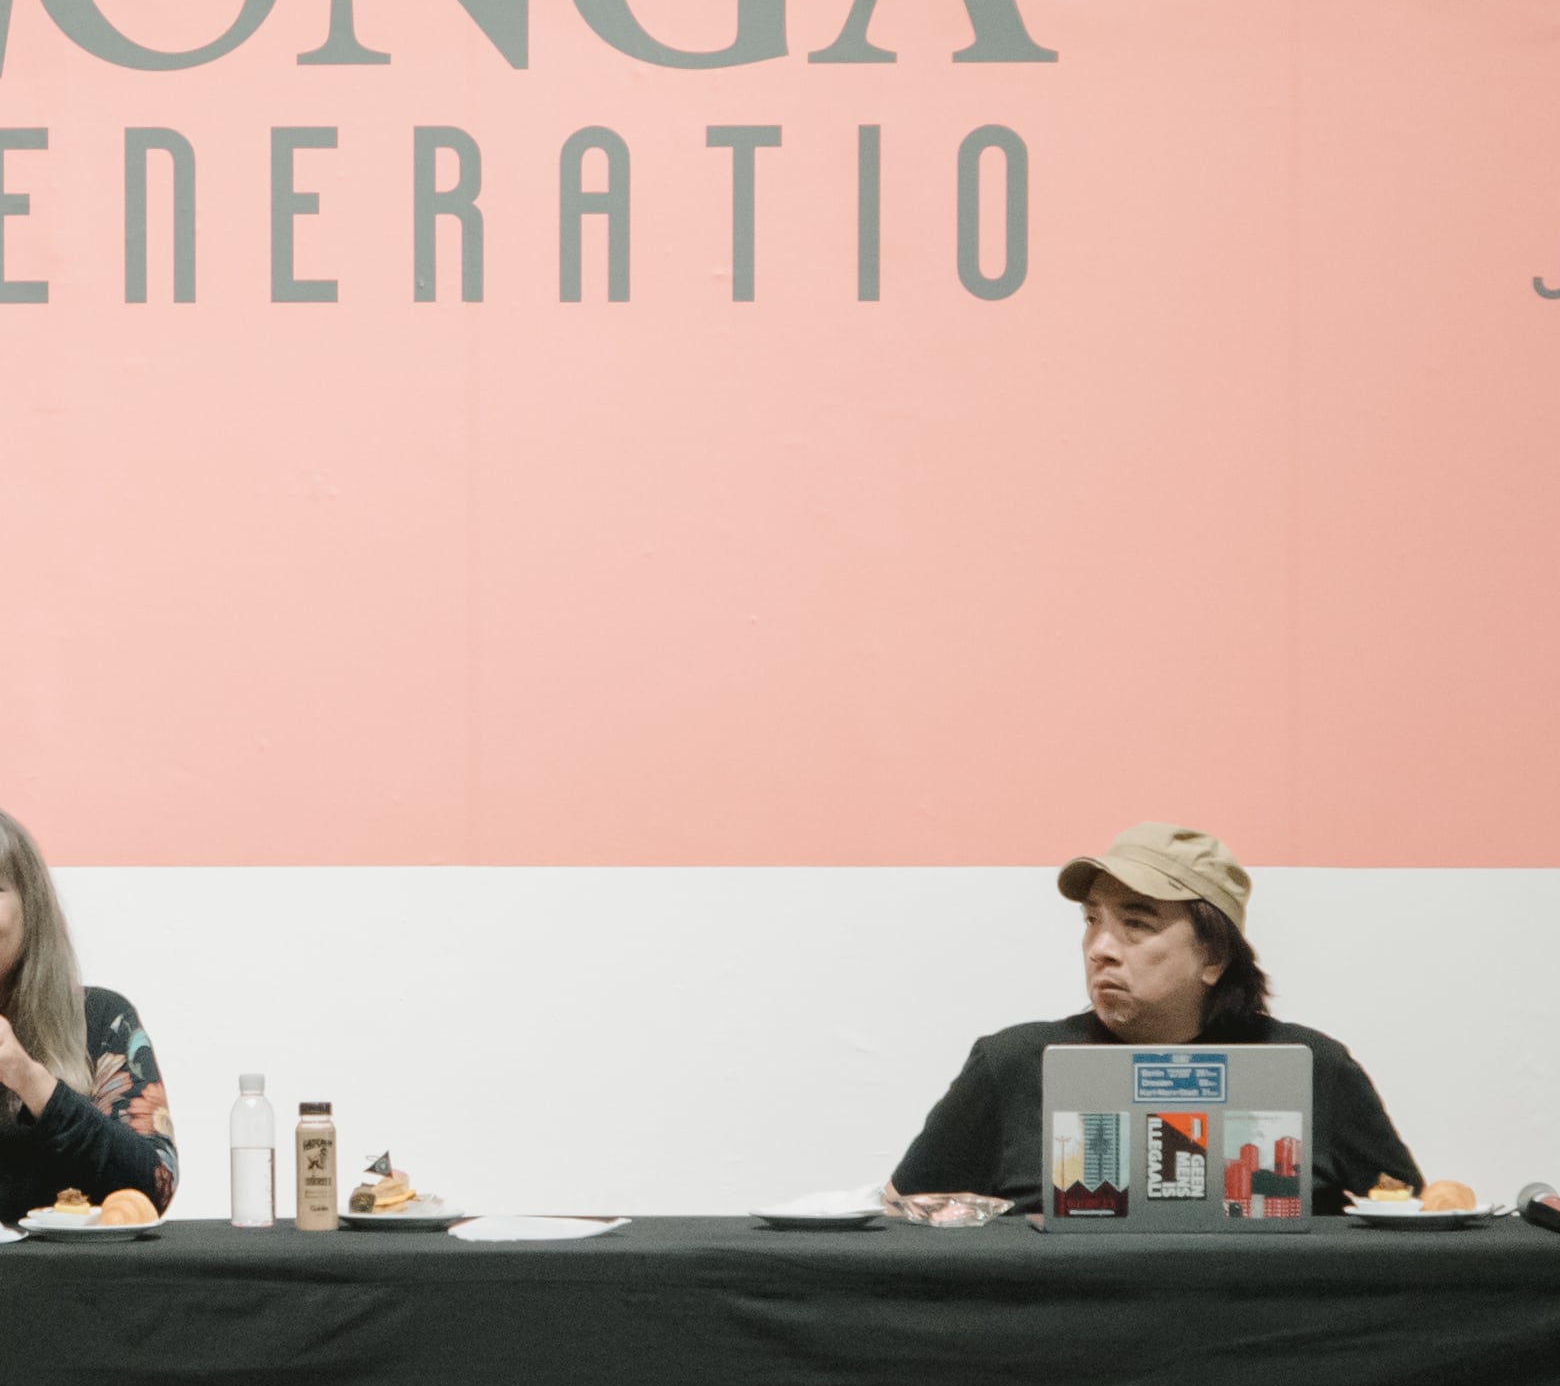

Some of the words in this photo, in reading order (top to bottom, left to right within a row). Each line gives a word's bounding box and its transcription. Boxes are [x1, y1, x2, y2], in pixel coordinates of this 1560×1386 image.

[1162, 1181, 1176, 1197] IS
[1177, 1151, 1192, 1197] MENS
[1192, 1154, 1205, 1197] GEEN
